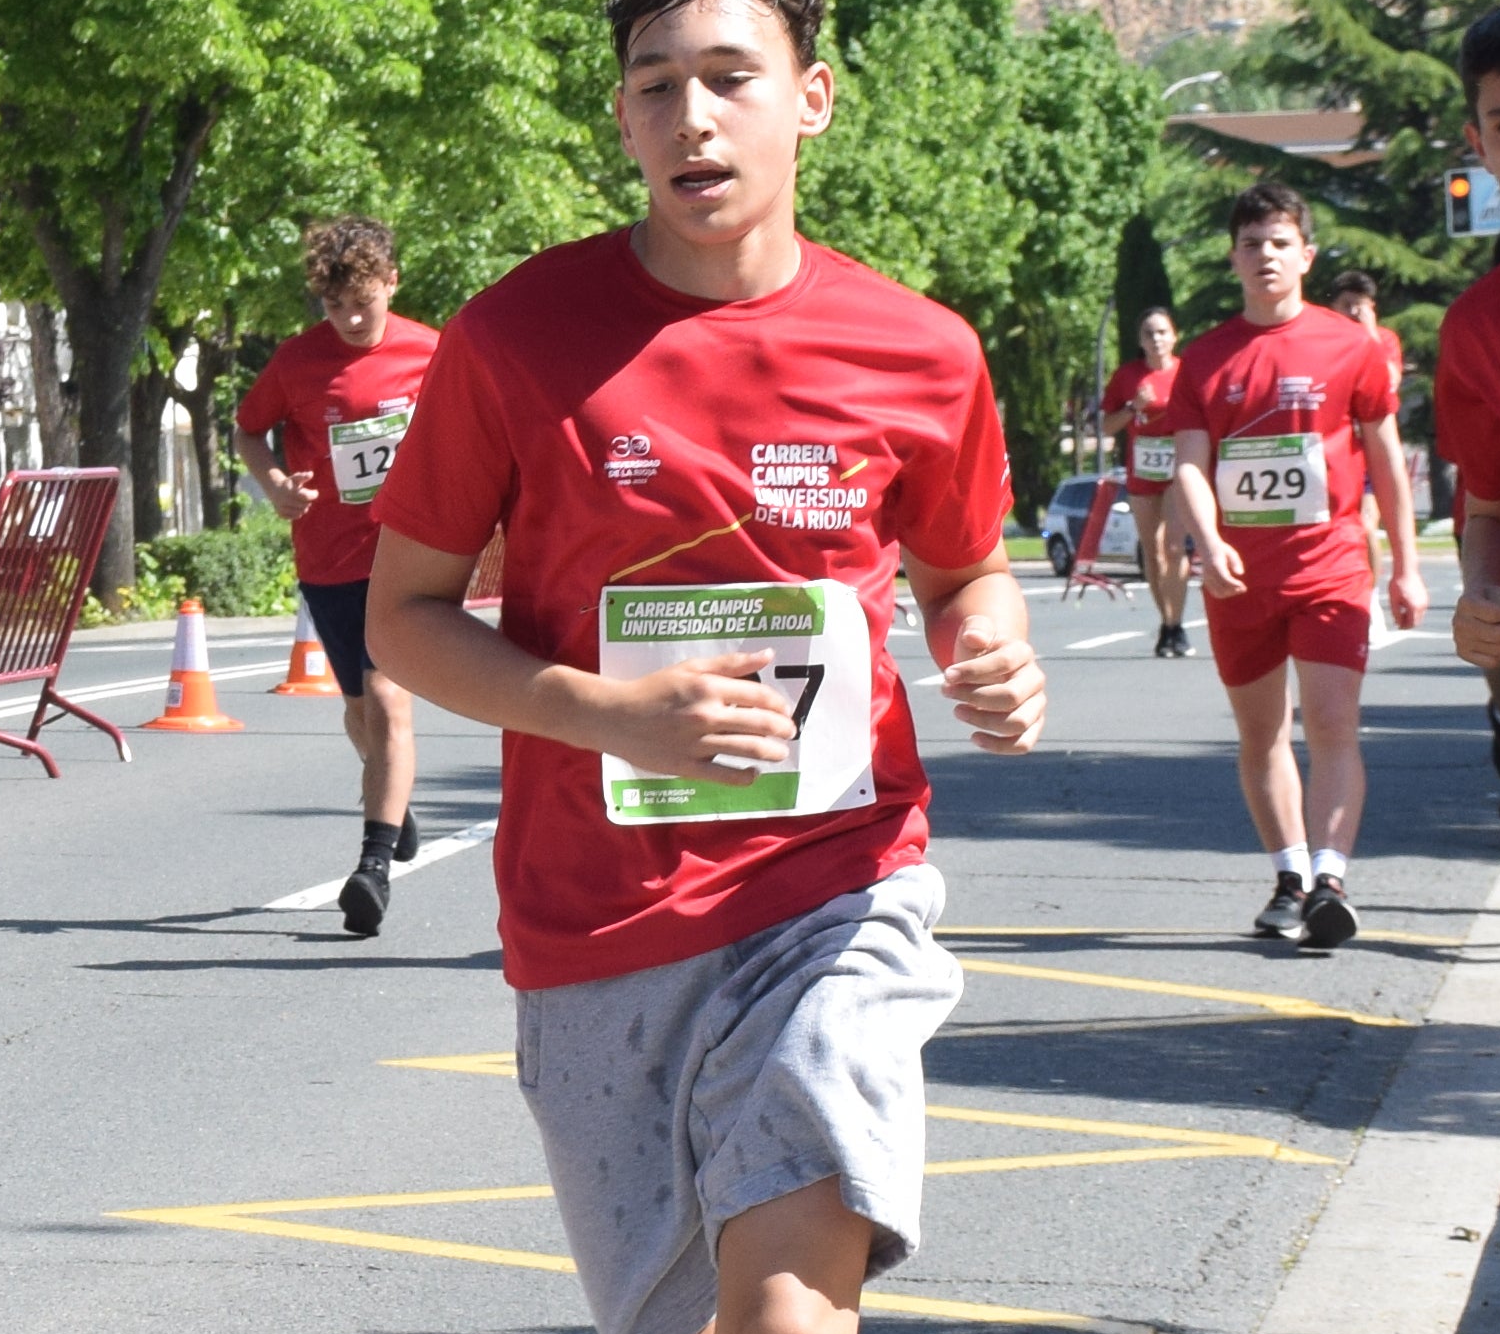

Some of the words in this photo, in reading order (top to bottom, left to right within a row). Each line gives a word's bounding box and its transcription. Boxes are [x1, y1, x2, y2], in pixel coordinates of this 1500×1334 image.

[352, 441, 400, 479] 12
[751, 444, 838, 465] CARRERA
[751, 466, 830, 487] CAMPUS
[1236, 468, 1307, 501] 429
[754, 487, 868, 509] UNIVERSIDAD
[755, 506, 780, 526] DE
[781, 508, 805, 530] LA
[807, 509, 852, 531] RIOJA
[624, 601, 696, 618] CARRERA
[698, 598, 764, 616] CAMPUS
[621, 618, 723, 636] UNIVERSIDAD
[725, 616, 748, 632] DE
[748, 615, 768, 631] LA
[770, 614, 813, 631] RIOJA
